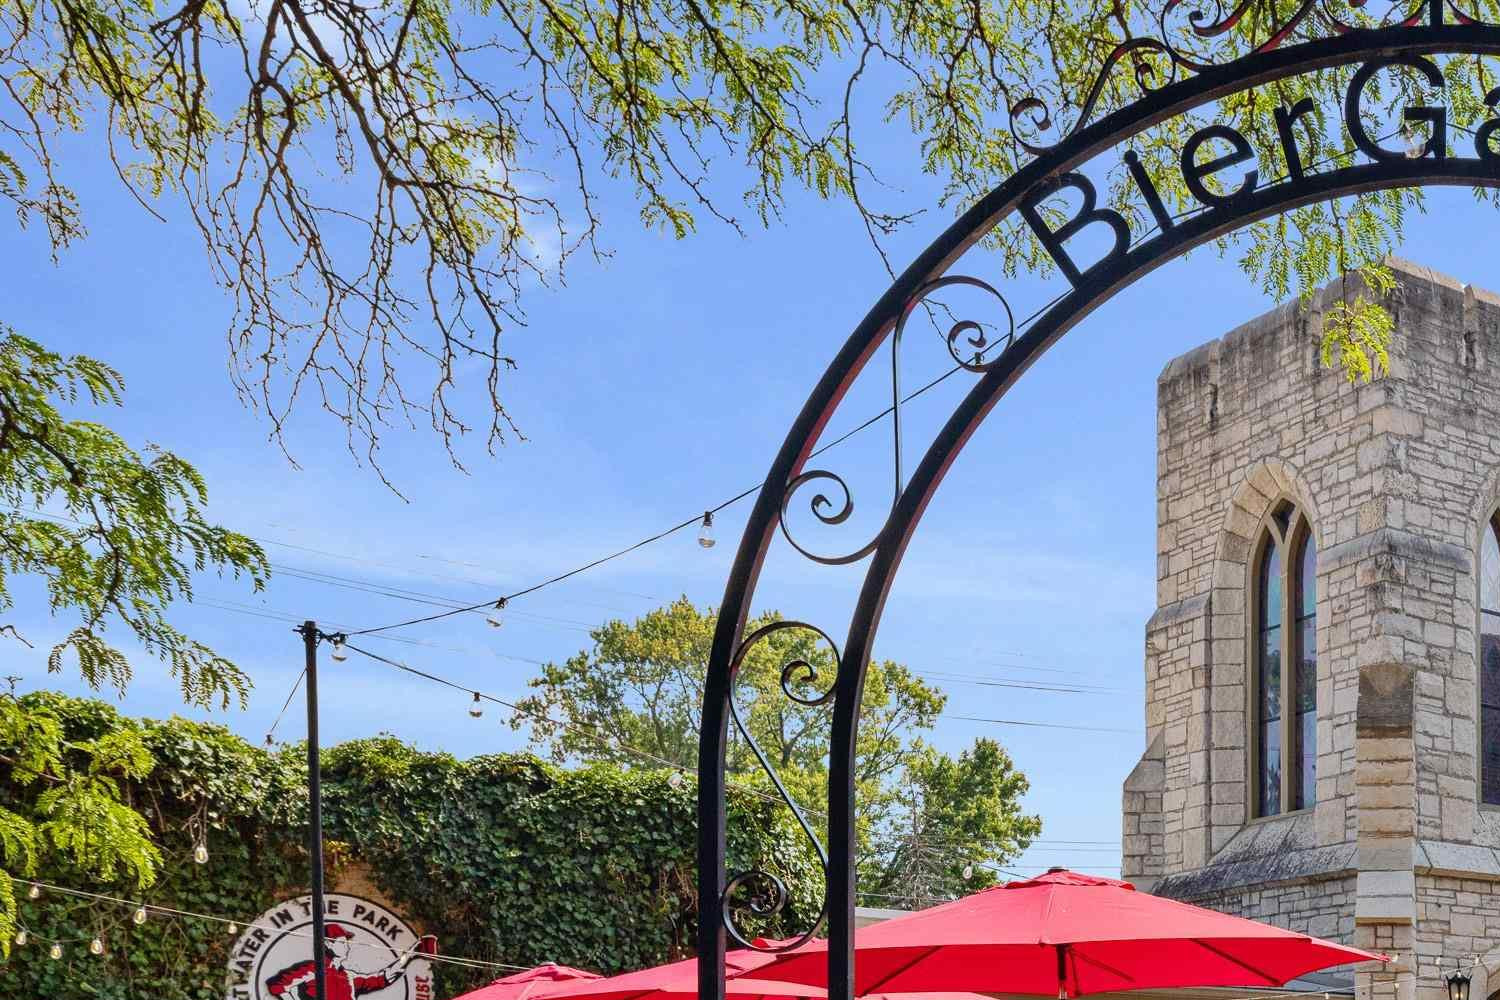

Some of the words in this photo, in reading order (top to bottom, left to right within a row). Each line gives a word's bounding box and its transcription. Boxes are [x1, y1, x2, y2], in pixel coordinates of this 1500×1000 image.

[269, 909, 294, 930] IN
[301, 900, 340, 917] TE
[353, 904, 403, 941] PARK
